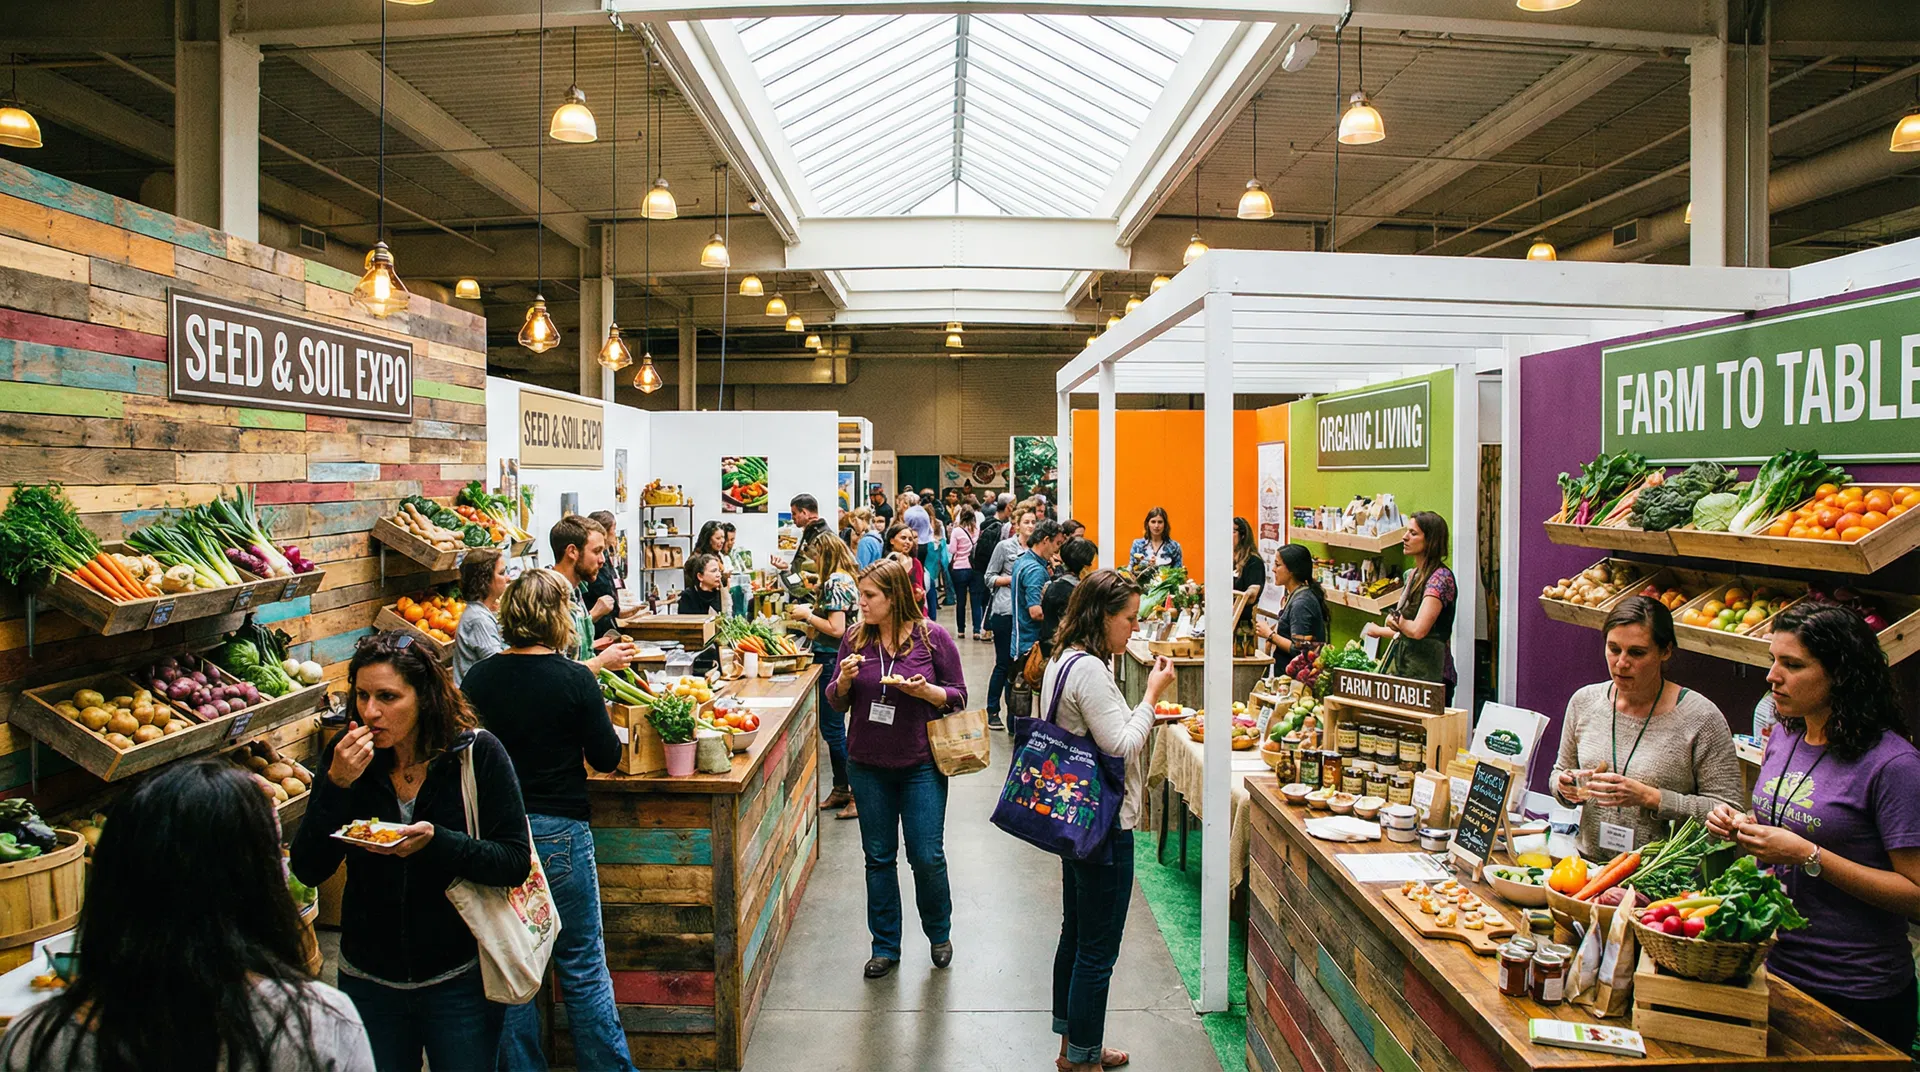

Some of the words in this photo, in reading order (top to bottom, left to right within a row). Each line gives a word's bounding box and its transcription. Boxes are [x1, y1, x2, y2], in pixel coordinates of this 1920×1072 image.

[186, 313, 263, 387] SEED
[271, 331, 293, 392] &
[299, 336, 351, 398] SOIL
[356, 348, 407, 406] EXPO
[1617, 365, 1705, 435] FARM
[1716, 356, 1764, 429] TO
[1776, 334, 1920, 425] TABLE
[524, 409, 550, 446] SEED
[552, 414, 560, 448] &
[562, 415, 580, 449] SOIL
[582, 419, 602, 450] EXPO
[1320, 410, 1371, 452] ORGANIC
[1375, 403, 1422, 449] LIVING
[1340, 675, 1372, 697] FARM
[1374, 681, 1390, 700] TO
[1393, 684, 1432, 708] TABLE
